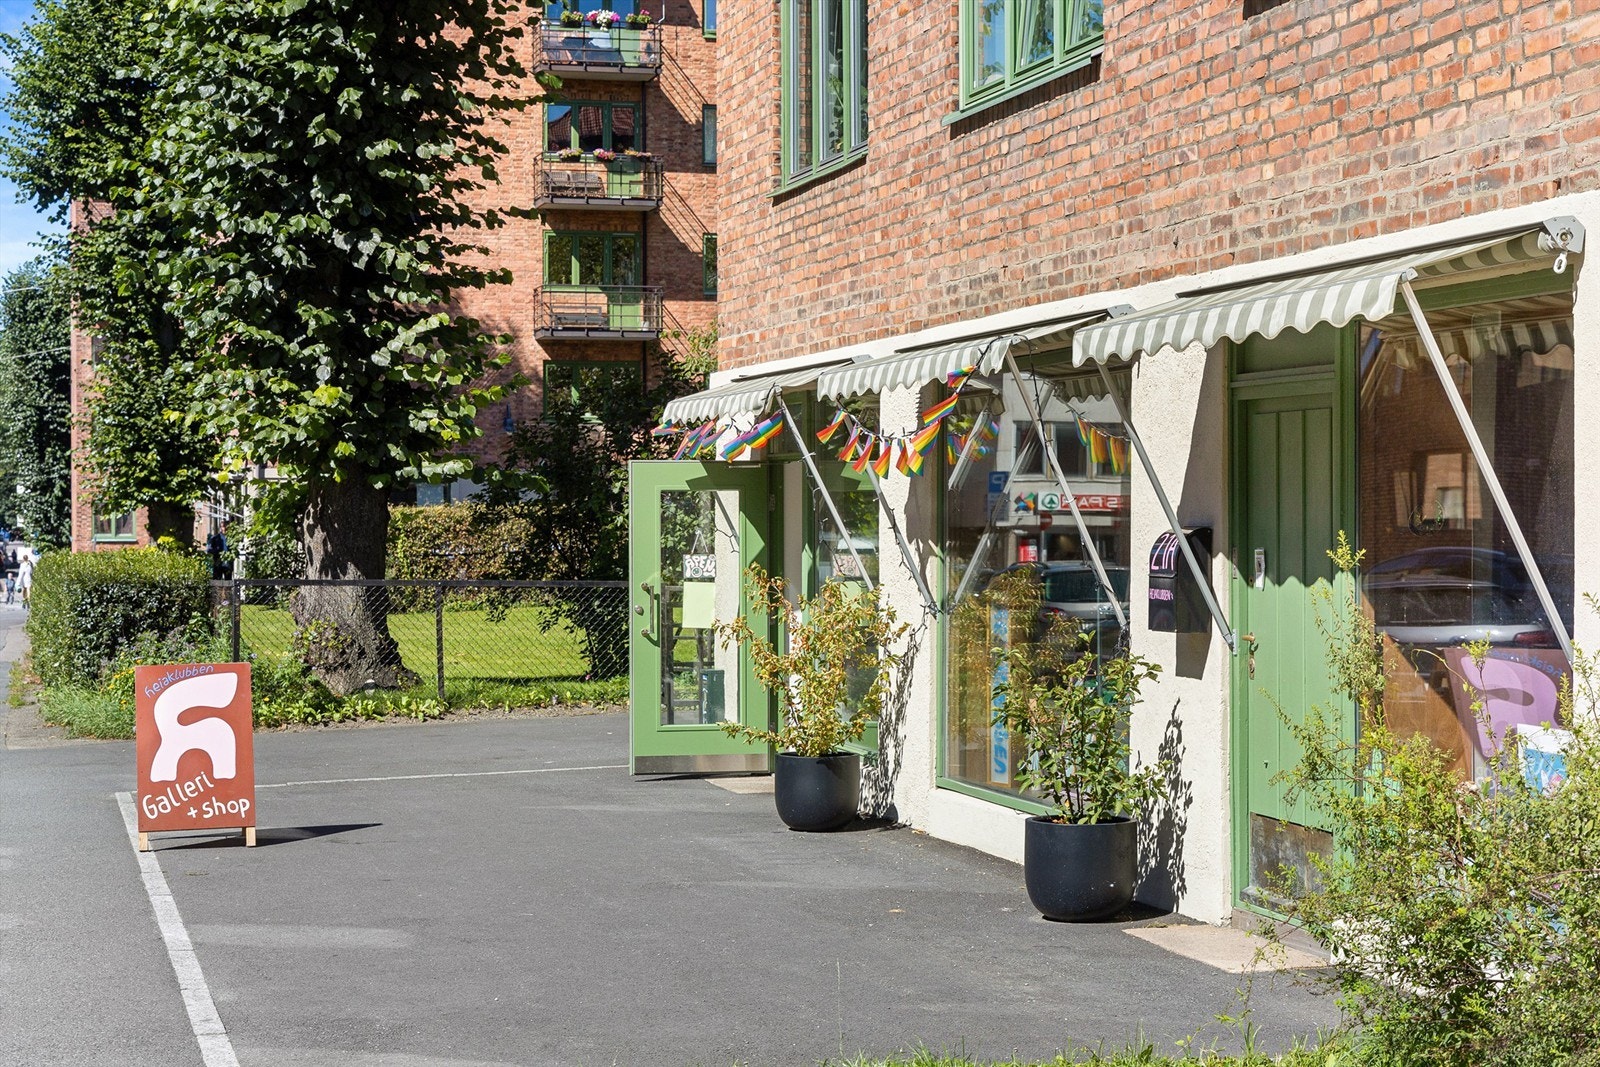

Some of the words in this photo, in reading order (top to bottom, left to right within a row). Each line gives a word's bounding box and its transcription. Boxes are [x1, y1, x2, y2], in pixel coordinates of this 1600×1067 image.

[144, 664, 214, 699] heiaklubben
[142, 771, 214, 820] Galleri
[202, 797, 250, 819] shop
